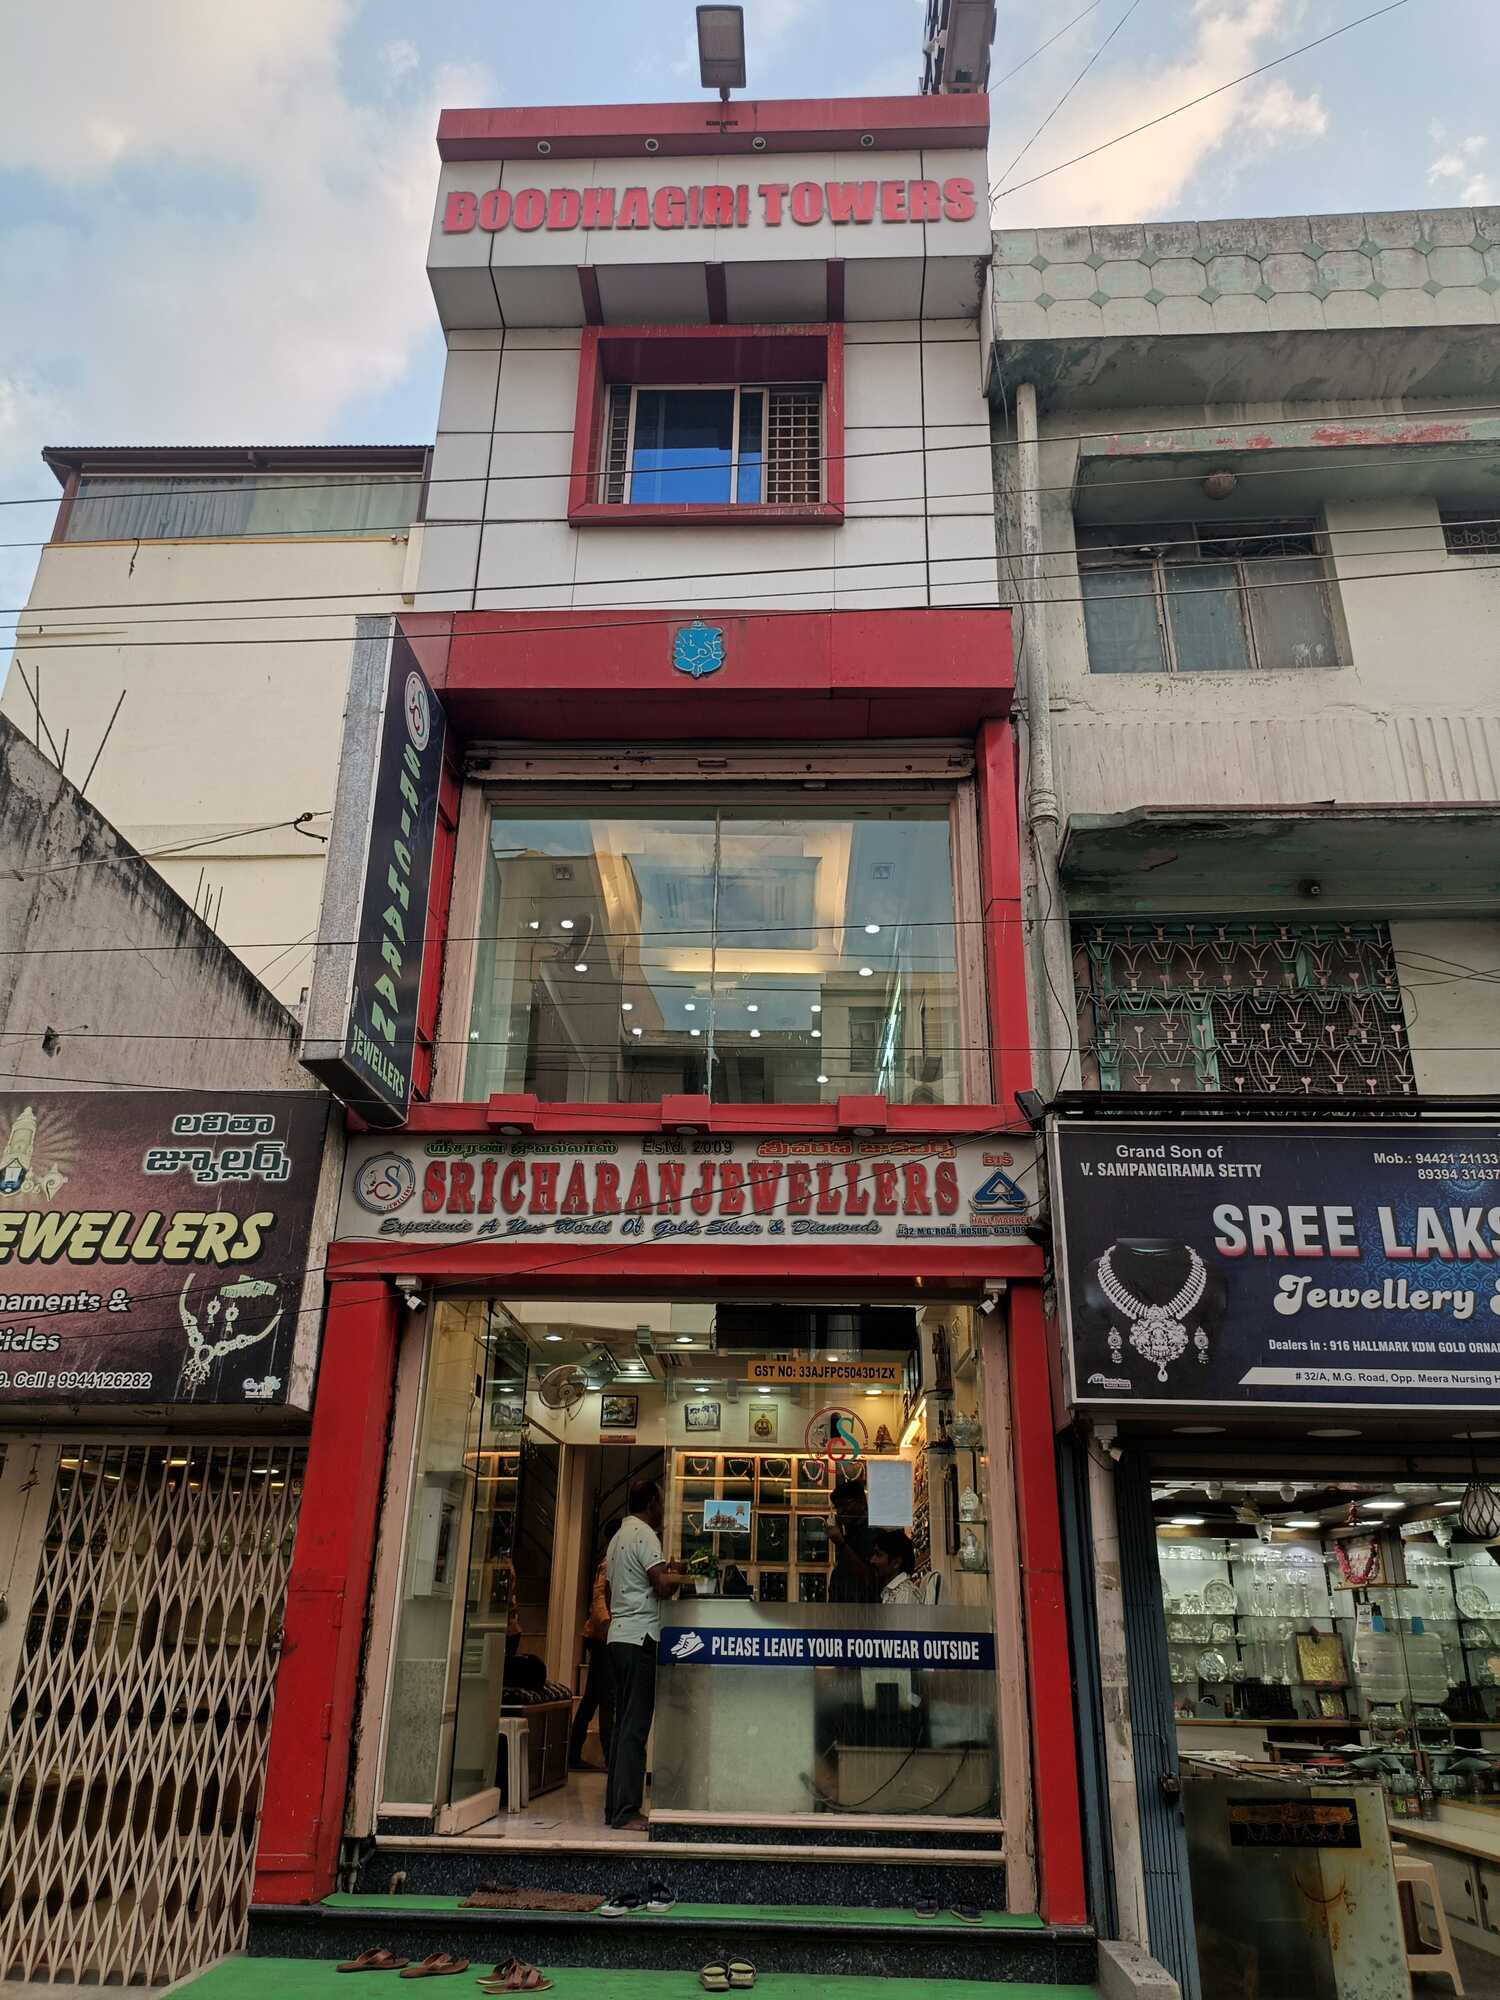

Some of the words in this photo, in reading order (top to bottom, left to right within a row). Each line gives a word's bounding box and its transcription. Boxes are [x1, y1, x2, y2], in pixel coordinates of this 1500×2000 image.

[443, 184, 749, 234] BOODHAGIRI
[758, 177, 977, 226] TOWERS
[371, 743, 421, 1048] SRICHARAN
[351, 1023, 405, 1099] JEWELLERS
[693, 1138, 733, 1154] 2009
[1116, 1144, 1166, 1158] Grand
[1170, 1144, 1202, 1158] Son
[1206, 1145, 1223, 1158] of
[983, 1154, 1014, 1166] BIS
[1373, 1152, 1412, 1164] Mob.:
[1415, 1153, 1455, 1164] 94421
[1459, 1153, 1499, 1165] 21133
[1080, 1162, 1093, 1176] V.
[1097, 1162, 1215, 1177] SAMPANGIRAMA
[1218, 1164, 1262, 1178] SETTY
[1417, 1168, 1458, 1180] 89394
[1461, 1169, 1500, 1180] 31437
[422, 1159, 686, 1215] SRICHARAN
[691, 1160, 961, 1216] JEWELLERS
[379, 1218, 473, 1236] Experience
[477, 1217, 500, 1235] A
[505, 1218, 548, 1235] New
[554, 1217, 613, 1235] World
[705, 1219, 763, 1235] Silver
[768, 1219, 785, 1235] &
[791, 1219, 883, 1235] Diamonds
[1212, 1203, 1360, 1257] SREE
[108, 1288, 131, 1312] &
[1273, 1273, 1474, 1320] Jewellery
[1268, 1339, 1308, 1351] Dealers
[1309, 1341, 1320, 1351] in
[1329, 1341, 1349, 1351] 916
[1352, 1341, 1409, 1352] HALLMARK
[1411, 1342, 1436, 1352] KDM
[1438, 1342, 1466, 1352] GOLD
[14, 1370, 47, 1388] Cell
[57, 1371, 152, 1389] 9944126282
[754, 1365, 776, 1377] GST
[778, 1365, 796, 1377] NO:
[799, 1366, 896, 1379] 33AJFPC5043D1ZX
[1295, 1372, 1301, 1380] #
[1304, 1372, 1330, 1383] 32/A,
[1332, 1372, 1356, 1382] M.G.
[1358, 1373, 1389, 1384] Road,
[1391, 1373, 1415, 1385] Opp.
[1418, 1373, 1449, 1383] Meera
[1451, 1374, 1492, 1385] Nursing
[711, 1636, 760, 1657] PLEASE
[764, 1637, 804, 1658] LEAVE
[807, 1638, 843, 1658] YOUR
[847, 1639, 920, 1660] FOOTWEAR
[923, 1641, 980, 1661] OUTSIDE
